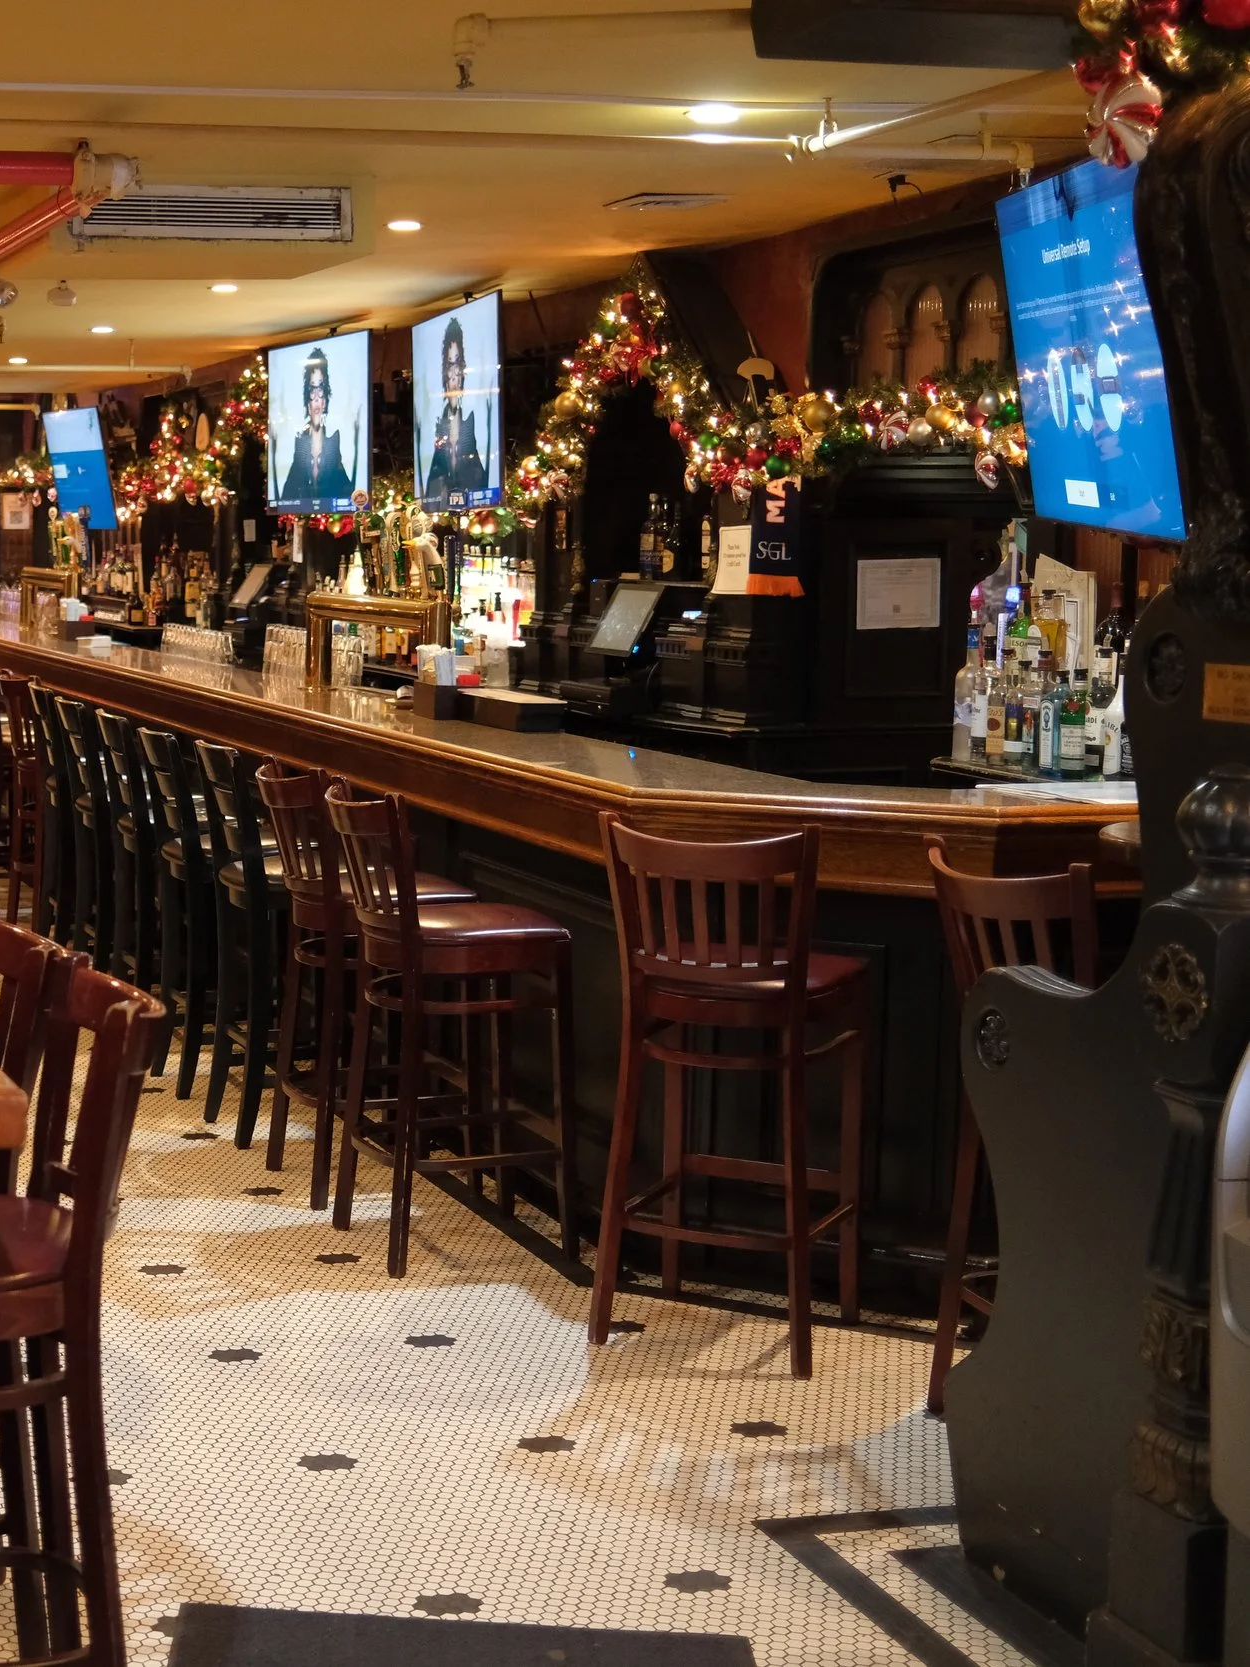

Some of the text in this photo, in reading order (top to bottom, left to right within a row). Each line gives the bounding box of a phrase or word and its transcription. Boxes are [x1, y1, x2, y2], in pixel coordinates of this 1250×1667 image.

[1041, 238, 1091, 264] Universal Remote Setup
[449, 496, 465, 505] IPA
[756, 541, 792, 561] SGL
